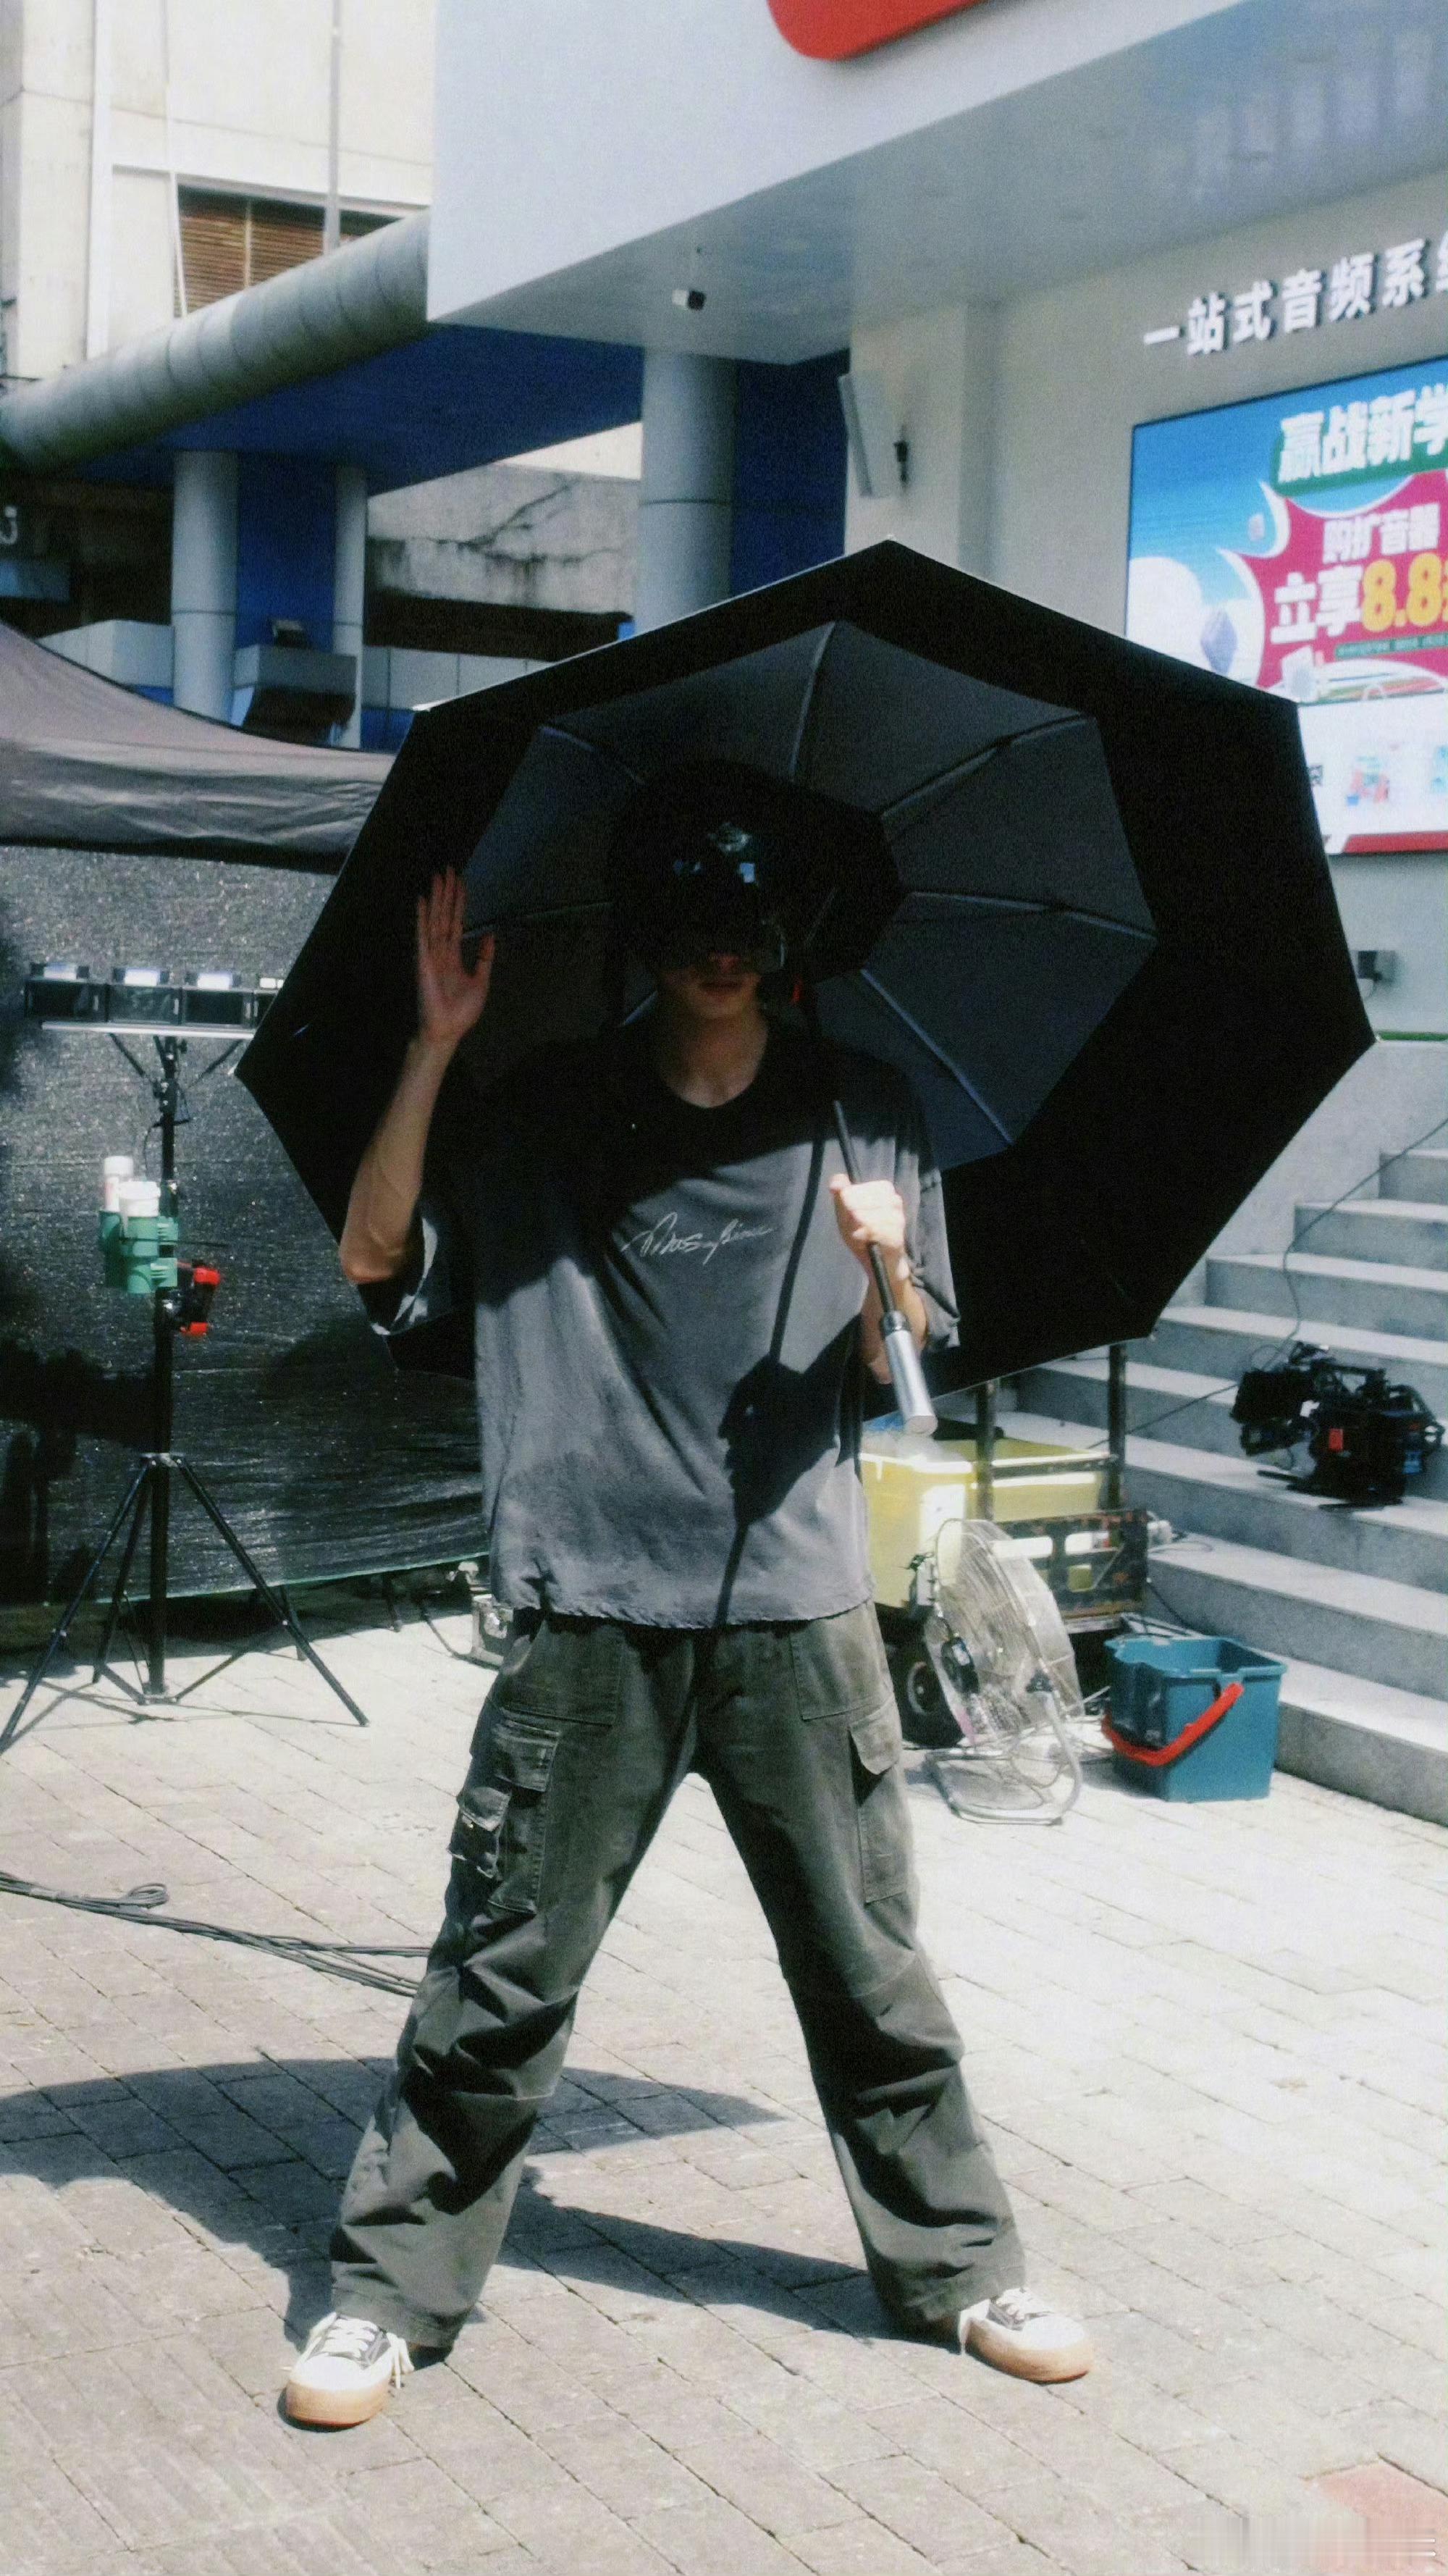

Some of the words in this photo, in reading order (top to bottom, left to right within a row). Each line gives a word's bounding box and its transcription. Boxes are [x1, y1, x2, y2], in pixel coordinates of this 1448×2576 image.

[1144, 230, 1448, 356] 一站式音频系
[1270, 552, 1448, 645] 立享8.8
